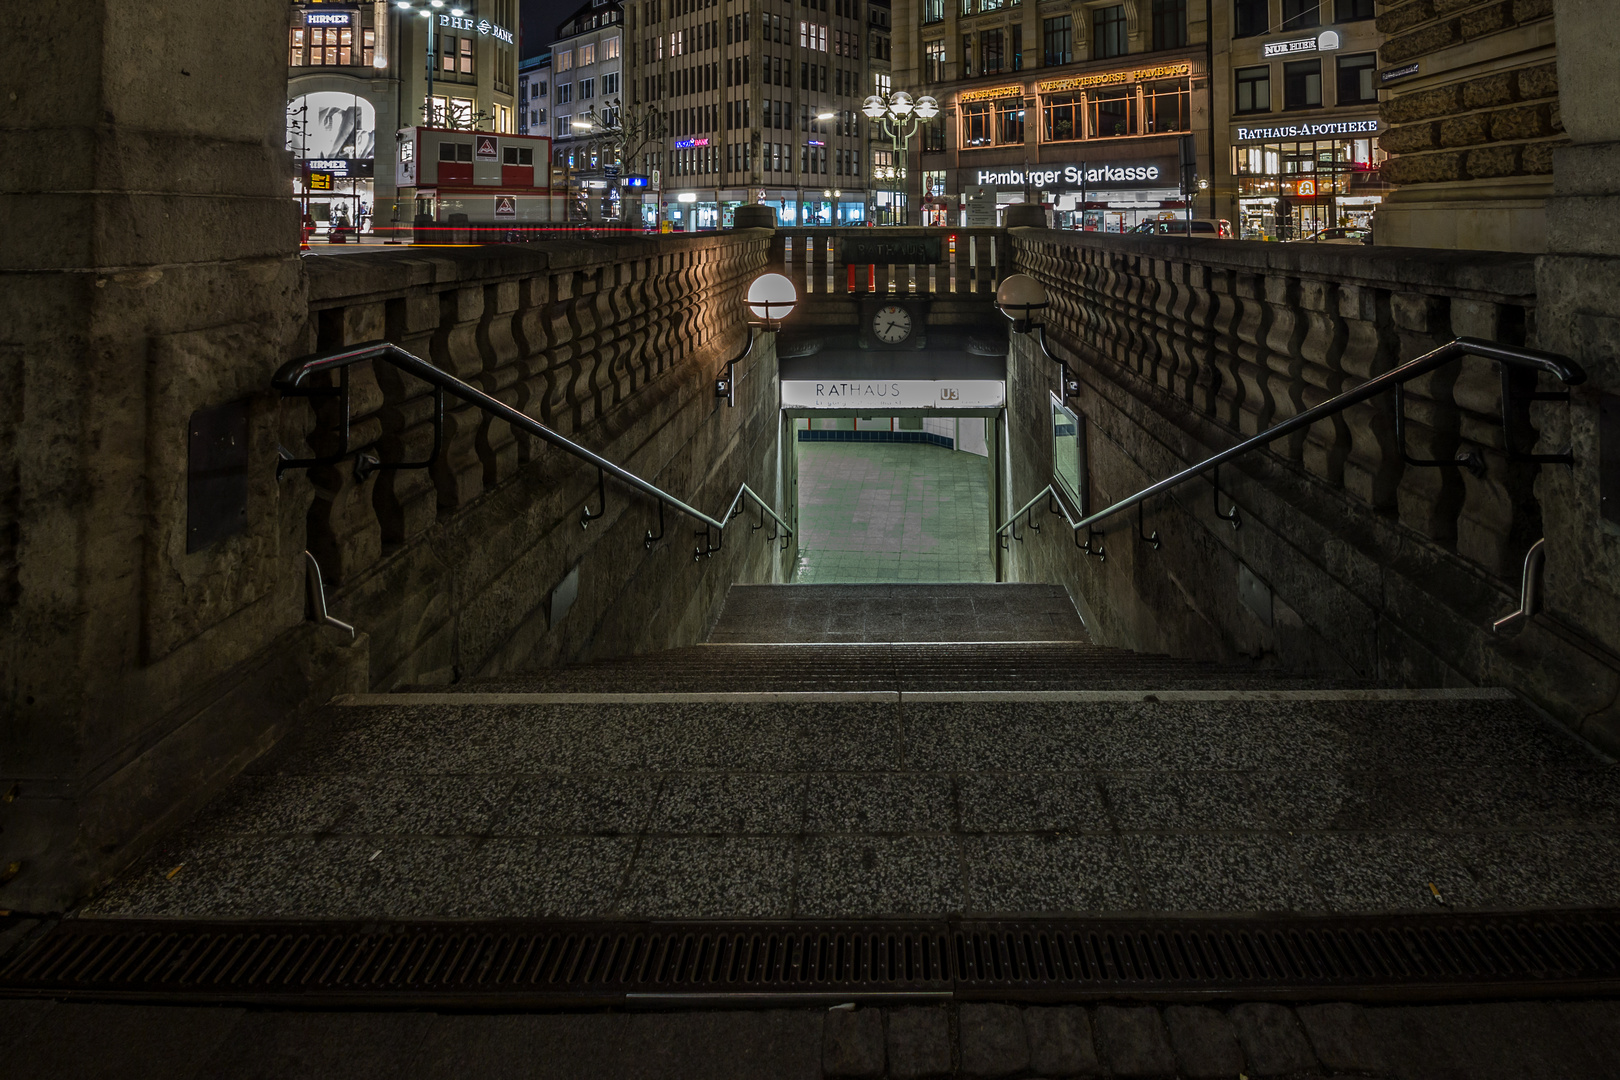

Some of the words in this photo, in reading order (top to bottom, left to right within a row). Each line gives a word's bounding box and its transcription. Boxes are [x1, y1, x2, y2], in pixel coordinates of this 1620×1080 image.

[308, 15, 349, 23] HIRMER
[439, 15, 474, 31] BHF
[492, 25, 514, 45] BANK
[1265, 43, 1288, 54] NUR
[1289, 40, 1317, 51] HIER
[1040, 73, 1127, 91] WERTPAPIERBÖRSE
[1133, 64, 1188, 80] HAMBURG
[962, 86, 1021, 101] HANSEATISCHE
[978, 170, 1061, 188] Hamburger
[1064, 165, 1159, 186] Sparkasse
[857, 244, 926, 256] RATHAUS
[816, 383, 900, 397] RATHAUS
[941, 388, 959, 401] U3
